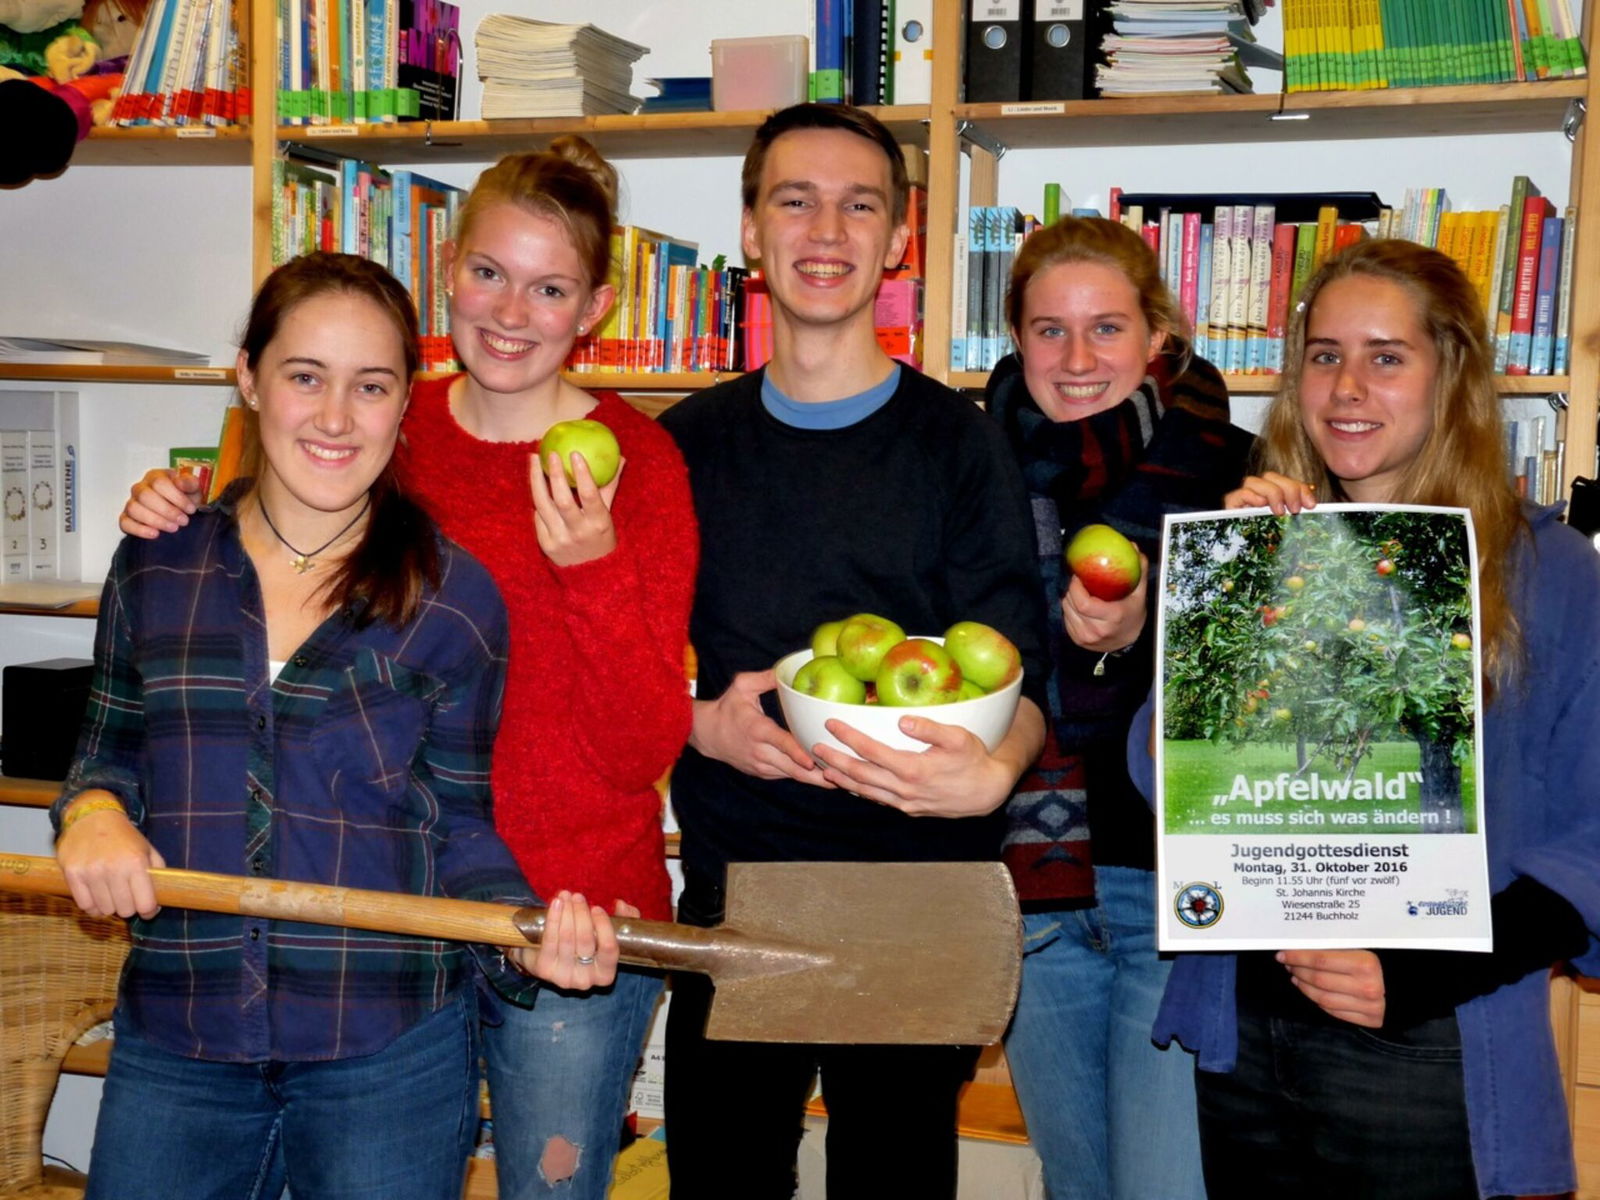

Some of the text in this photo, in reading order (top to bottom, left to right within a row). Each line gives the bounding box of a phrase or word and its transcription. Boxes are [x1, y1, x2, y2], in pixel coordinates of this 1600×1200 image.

[1527, 213, 1539, 232] SPEED
[1517, 256, 1535, 319] MORITZ MATTHIES
[65, 459, 74, 533] BAUSTEINE
[40, 538, 47, 550] 3
[1211, 813, 1230, 825] es
[1236, 812, 1283, 825] muss
[1288, 810, 1325, 825] sich
[1331, 812, 1367, 825] was
[1374, 809, 1439, 825] ändern
[1231, 843, 1409, 860] Jugendgottesdienst
[1233, 862, 1408, 875] Montag, 31. Oktober 2016
[1242, 876, 1273, 887] Beginn
[1276, 876, 1303, 885] 11.55
[1306, 876, 1323, 885] Uhr
[1325, 875, 1349, 887] (fünf
[1370, 875, 1400, 887] zwölf)
[1276, 887, 1366, 897] St. Johannis Kirche
[1281, 900, 1360, 909] Wiesenstraße 25
[1284, 911, 1359, 921] 21244 Buchholz
[1426, 906, 1468, 916] JUGEND
